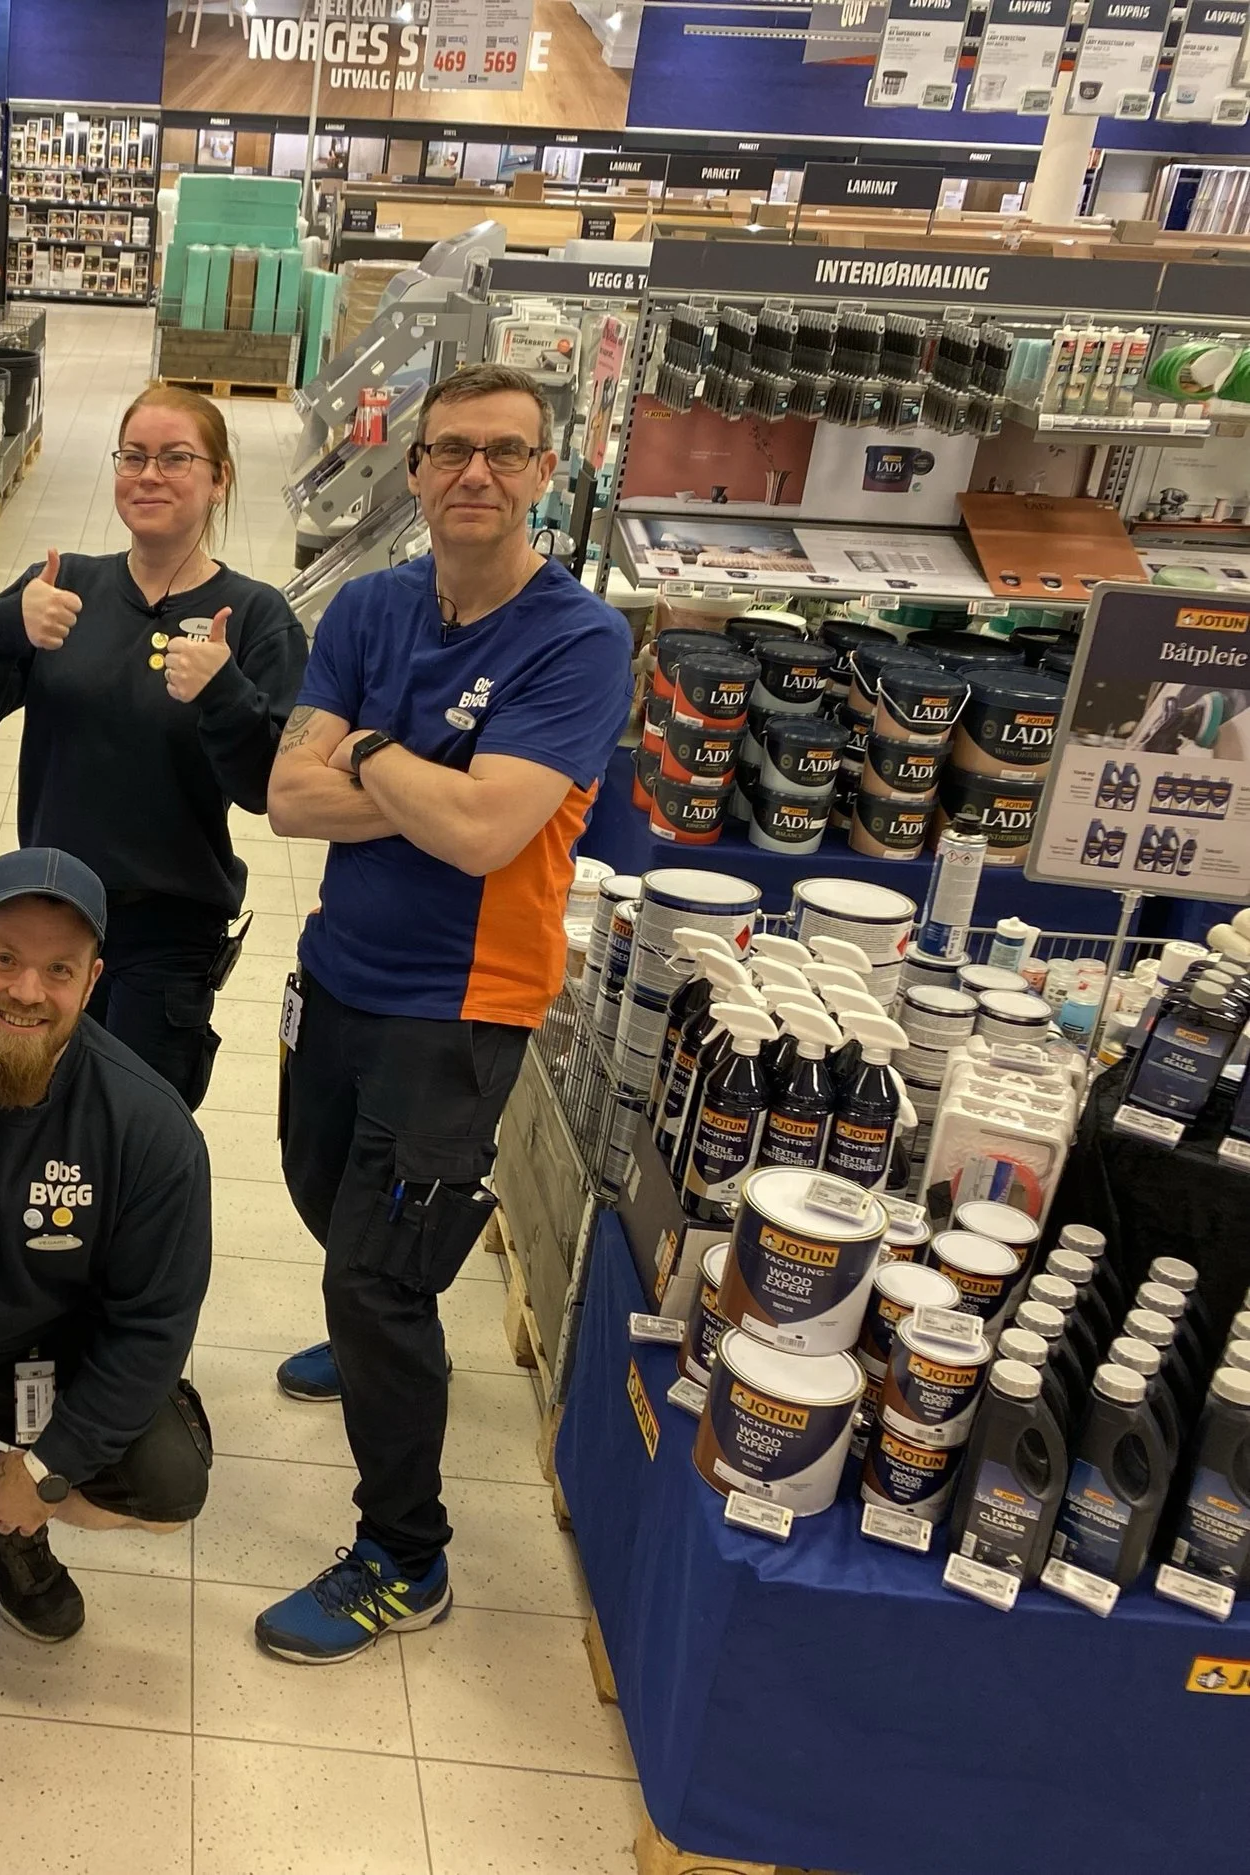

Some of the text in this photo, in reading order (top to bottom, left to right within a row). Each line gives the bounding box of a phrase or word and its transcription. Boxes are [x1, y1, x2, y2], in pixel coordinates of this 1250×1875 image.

[1009, 0, 1052, 14] LAVPRIS
[1108, 4, 1150, 19] LAVPRIS
[1205, 10, 1247, 24] LAVPRIS
[248, 19, 389, 65] NORGES
[434, 51, 466, 72] 469
[484, 51, 517, 73] 569
[330, 68, 391, 90] UTVALG
[395, 71, 417, 91] AV
[609, 161, 642, 173] LAMINAT
[702, 167, 741, 181] PARKETT
[847, 179, 898, 195] LAMINAT
[588, 271, 635, 289] VEGG &
[815, 259, 991, 290] INTERIØRMALING
[650, 411, 672, 419] JOTUN
[876, 461, 905, 473] LADY
[1195, 613, 1247, 630] JOTUN
[1160, 641, 1249, 668] Båtpleie
[710, 692, 748, 705] LADY
[912, 705, 953, 720] LADY
[1026, 715, 1053, 725] JOTUN
[1001, 724, 1057, 745] LADY
[694, 749, 734, 763] LADY
[798, 759, 835, 772] LADY
[898, 764, 938, 779] LADY
[682, 806, 721, 819] LADY
[1004, 801, 1031, 809] JOTUN
[772, 812, 813, 828] LADY
[981, 809, 1038, 828] LADY
[889, 821, 927, 835] LADY
[711, 1116, 747, 1131] JOTUN
[779, 1120, 816, 1136] JOTUN
[701, 1125, 742, 1143] YACHTING
[769, 1131, 812, 1147] YACHTING
[848, 1127, 884, 1142] JOTUN
[702, 1139, 734, 1155] TEXTILE
[771, 1145, 803, 1160] TEXTILE
[836, 1138, 881, 1153] YACHTING
[839, 1152, 874, 1166] TEXTILE
[44, 1160, 81, 1182] Obs
[29, 1182, 92, 1207] BYGG
[778, 1240, 835, 1264] JOTUN
[764, 1252, 825, 1277] YACHTING
[770, 1266, 813, 1287] WOOD
[765, 1274, 813, 1296] EXPERT
[955, 1277, 1000, 1293] JOTUN
[926, 1369, 975, 1384] JOTUN
[914, 1377, 965, 1395] YACHTING
[919, 1395, 954, 1408] EXPERT
[922, 1390, 953, 1402] WOOD
[634, 1386, 658, 1450] JOTUN
[747, 1399, 805, 1426] JOTUN
[734, 1409, 794, 1438] YACHTING
[739, 1424, 782, 1448] WOOD
[736, 1432, 783, 1457] EXPERT
[896, 1448, 944, 1467] JOTUN
[885, 1455, 934, 1477] YACHTING
[890, 1474, 922, 1490] EXPERT
[892, 1469, 922, 1483] WOOD
[976, 1492, 1039, 1520] YACHTING
[1066, 1491, 1130, 1524] YACHTING
[979, 1511, 1026, 1533] CLEANER
[991, 1507, 1017, 1522] TEAK
[1069, 1503, 1120, 1530] BOATWASH
[1192, 1510, 1248, 1536] WATERLINE
[1192, 1520, 1241, 1542] CLEANER
